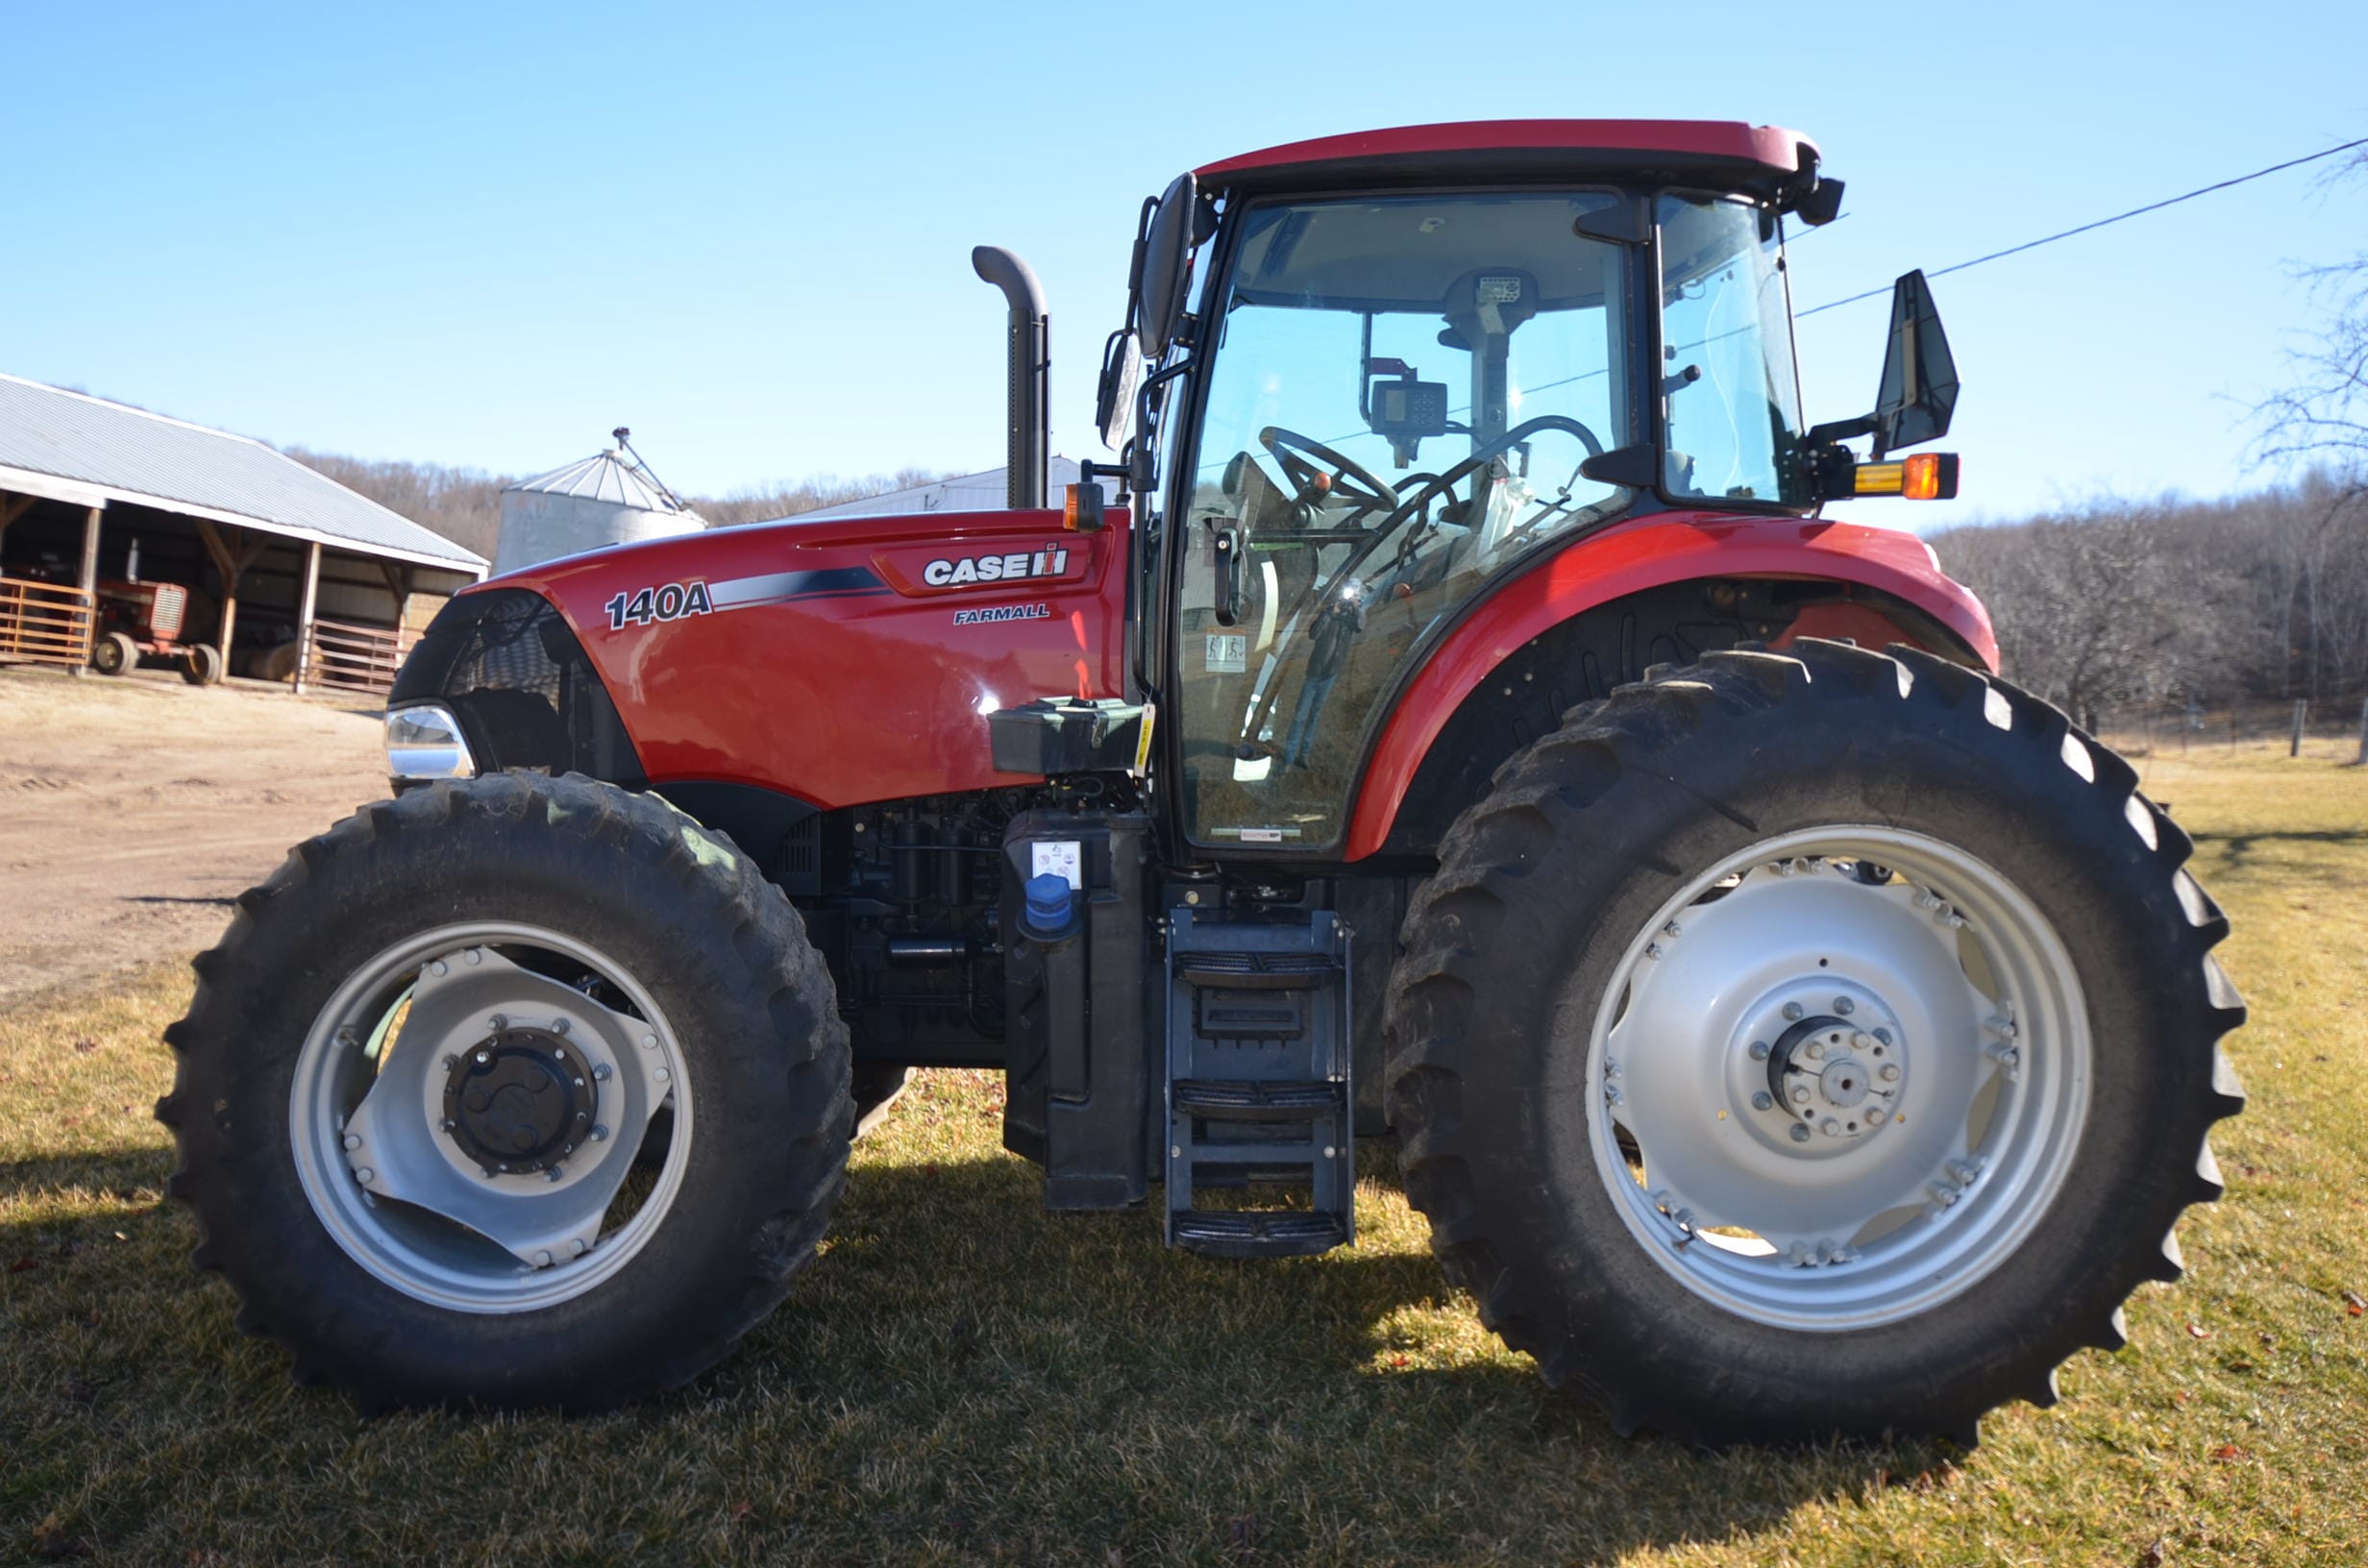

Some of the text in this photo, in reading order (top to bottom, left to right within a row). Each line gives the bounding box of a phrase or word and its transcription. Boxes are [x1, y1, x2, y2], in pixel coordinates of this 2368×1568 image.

[924, 553, 1030, 586] CASE
[604, 581, 711, 630] 140A
[953, 603, 1050, 625] FARMALL
